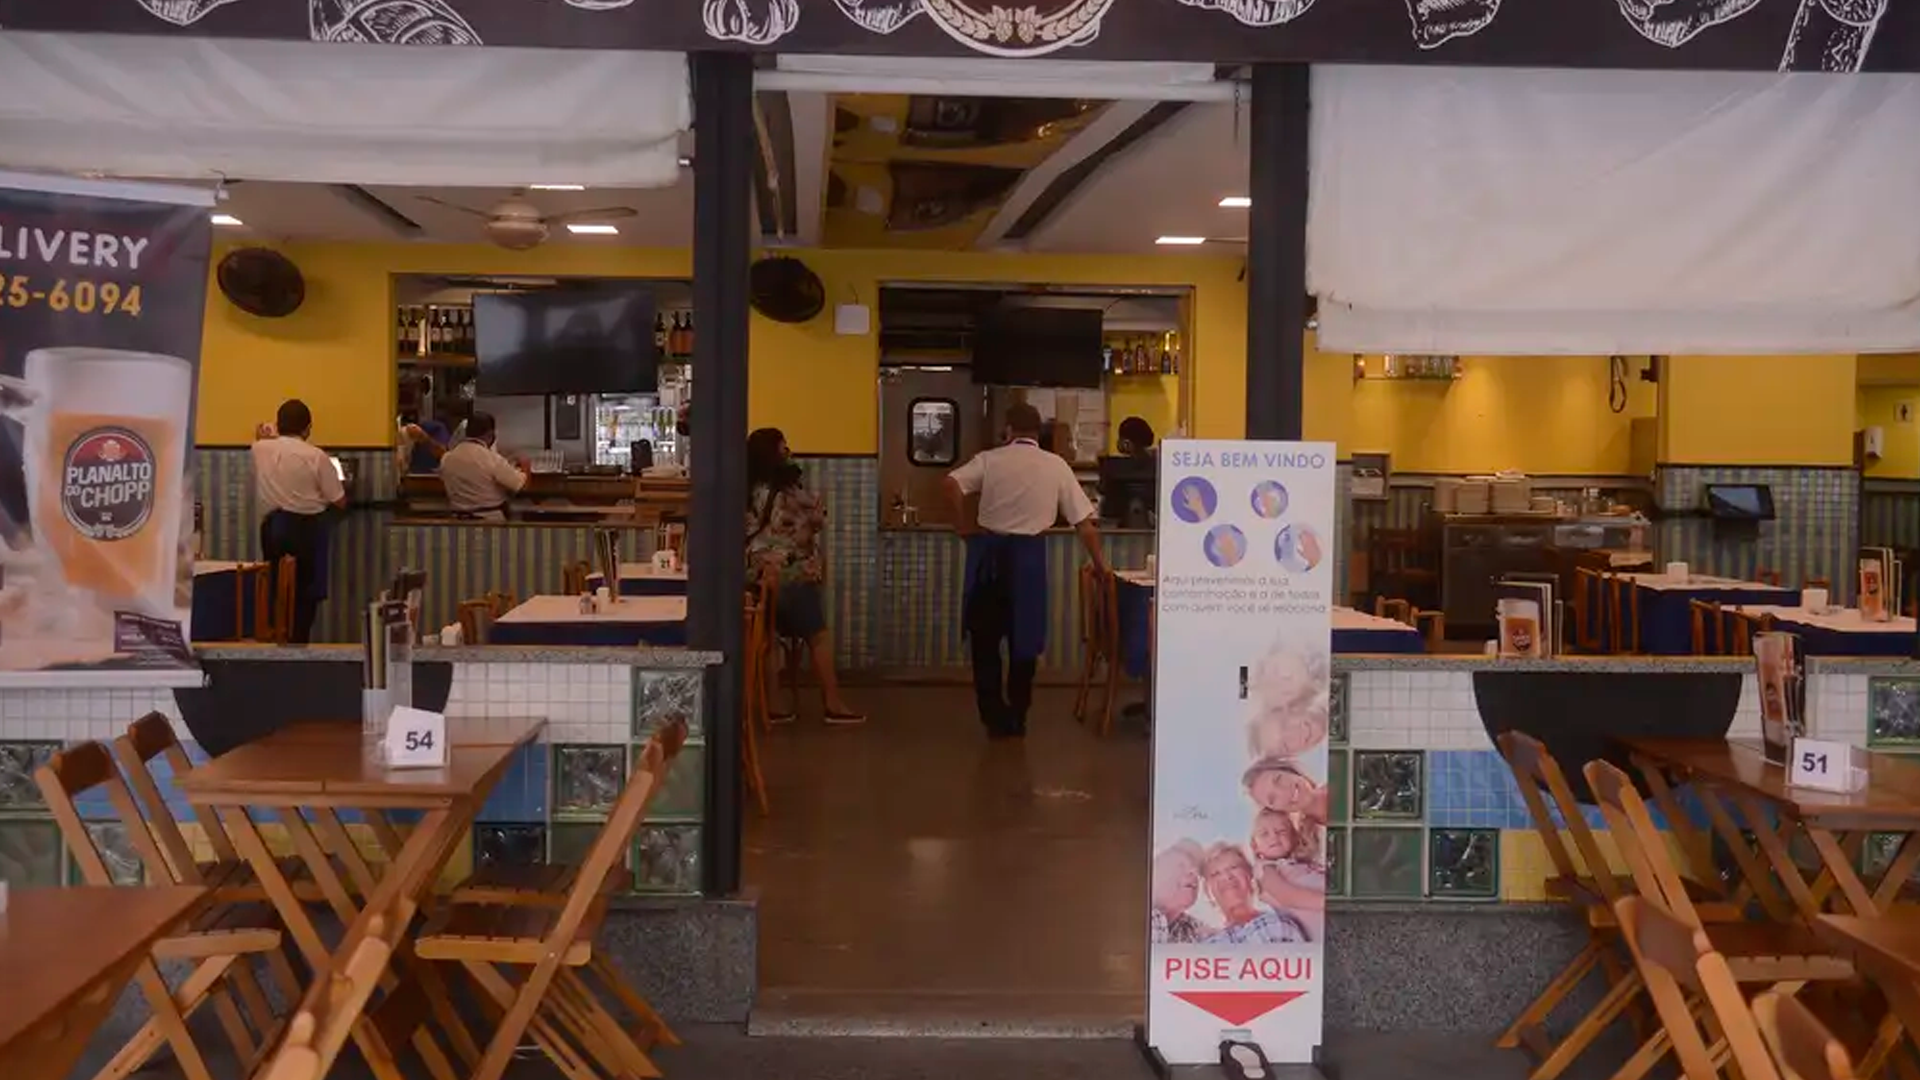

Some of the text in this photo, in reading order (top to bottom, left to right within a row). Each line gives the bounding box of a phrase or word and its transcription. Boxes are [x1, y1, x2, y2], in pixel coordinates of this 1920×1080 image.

[0, 225, 148, 269] LIVERY
[0, 273, 142, 316] 5-6094
[1171, 451, 1326, 469] SEJA BEM VINDO
[67, 462, 151, 484] PLANALTO
[80, 481, 150, 508] CHOPP
[1163, 575, 1188, 587] Aqui
[1162, 588, 1247, 601] contaminação
[1288, 589, 1320, 601] todos
[1162, 604, 1188, 613] com
[1191, 604, 1223, 615] quem
[1227, 603, 1255, 613] você
[1273, 604, 1326, 614] relaciona
[405, 730, 433, 751] 54
[1802, 752, 1828, 774] 51
[1165, 957, 1311, 981] PISE AQUI
